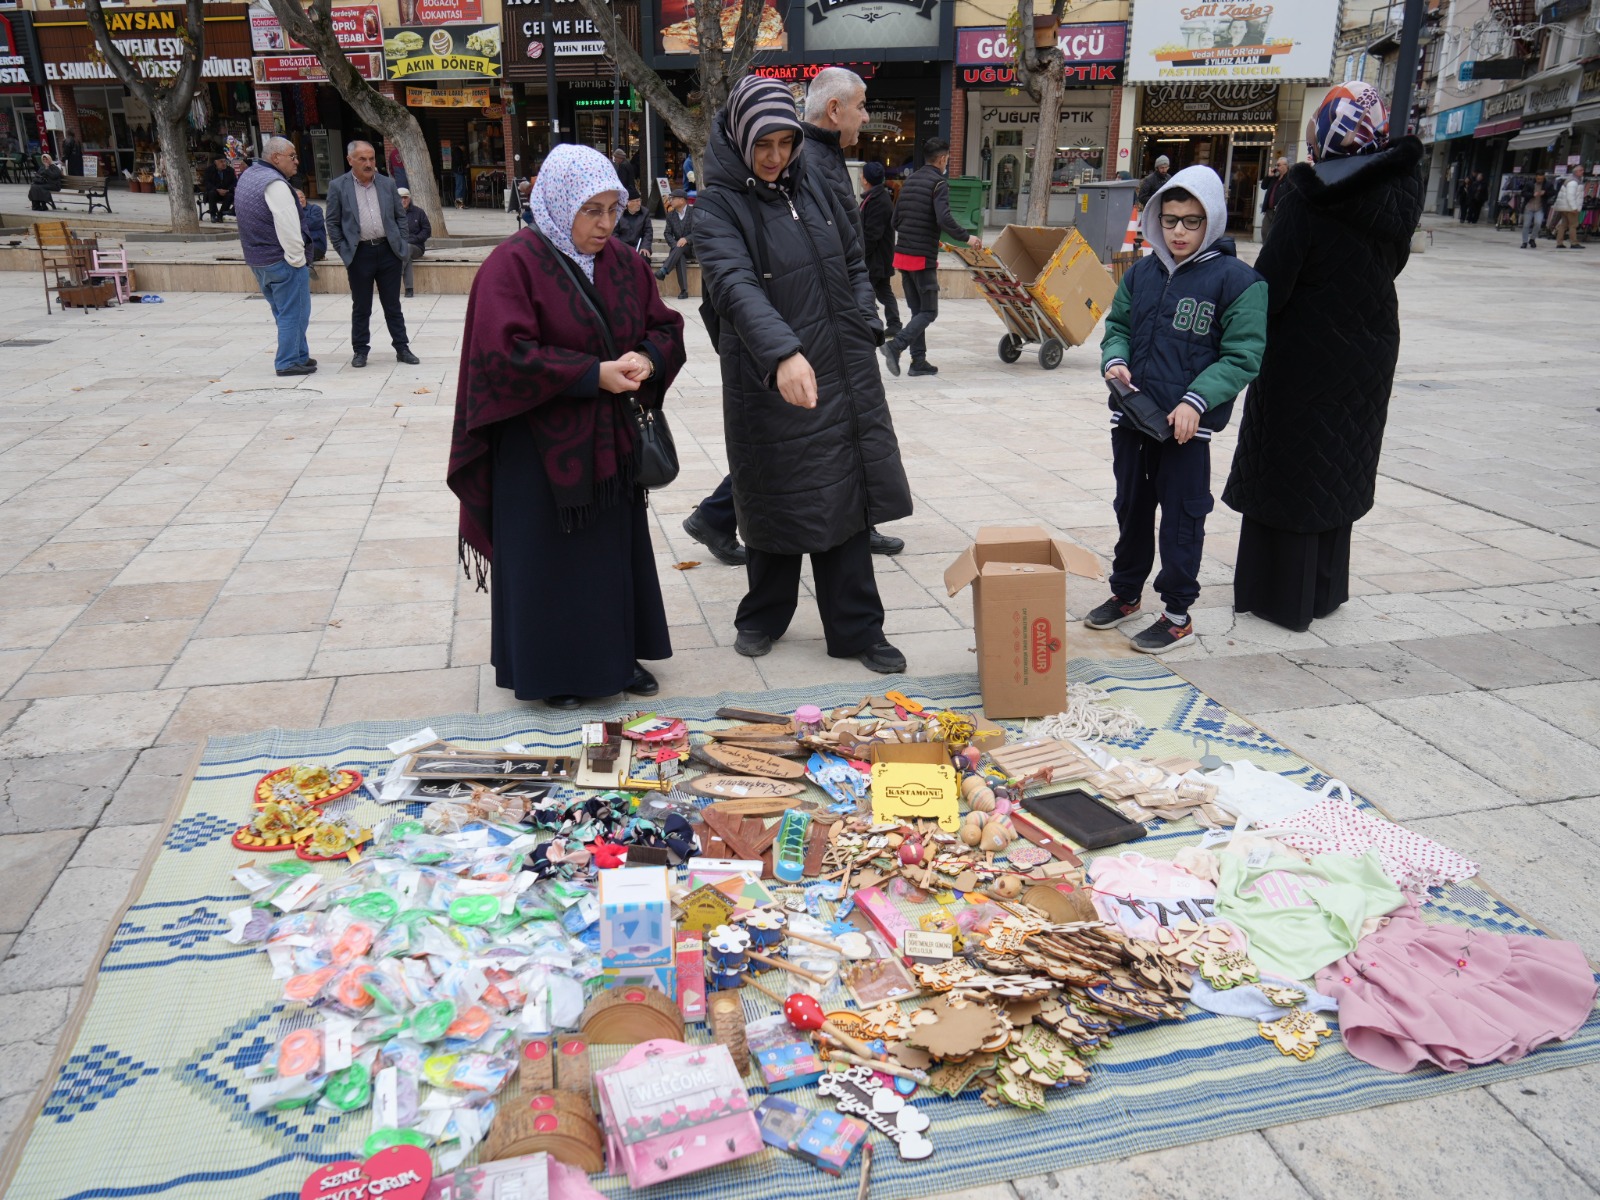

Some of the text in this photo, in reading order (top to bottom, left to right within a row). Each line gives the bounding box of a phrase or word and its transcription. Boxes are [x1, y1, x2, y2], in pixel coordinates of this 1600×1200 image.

[103, 11, 175, 31] AYSAN
[421, 10, 463, 20] LOKANTASI
[331, 20, 357, 31] ÖPRÜ
[335, 33, 365, 43] EBABI
[1192, 51, 1215, 59] Vedat
[1235, 56, 1260, 65] ALAN
[44, 63, 61, 80] EL
[201, 56, 252, 78] RÜNLER
[406, 56, 484, 73] AKIN DÖNER
[0, 68, 30, 83] STA
[963, 64, 1117, 83] UĞU PTİK
[1158, 66, 1282, 78] PASTIRMA SUCUK
[998, 111, 1094, 123] UĞUR PTİK
[1196, 112, 1273, 122] PASTIRMA SUCUK
[1172, 297, 1216, 336] 86
[1035, 621, 1048, 671] ÇAYKUR
[888, 789, 940, 797] KASTAMONU
[635, 1068, 714, 1102] WELCOME
